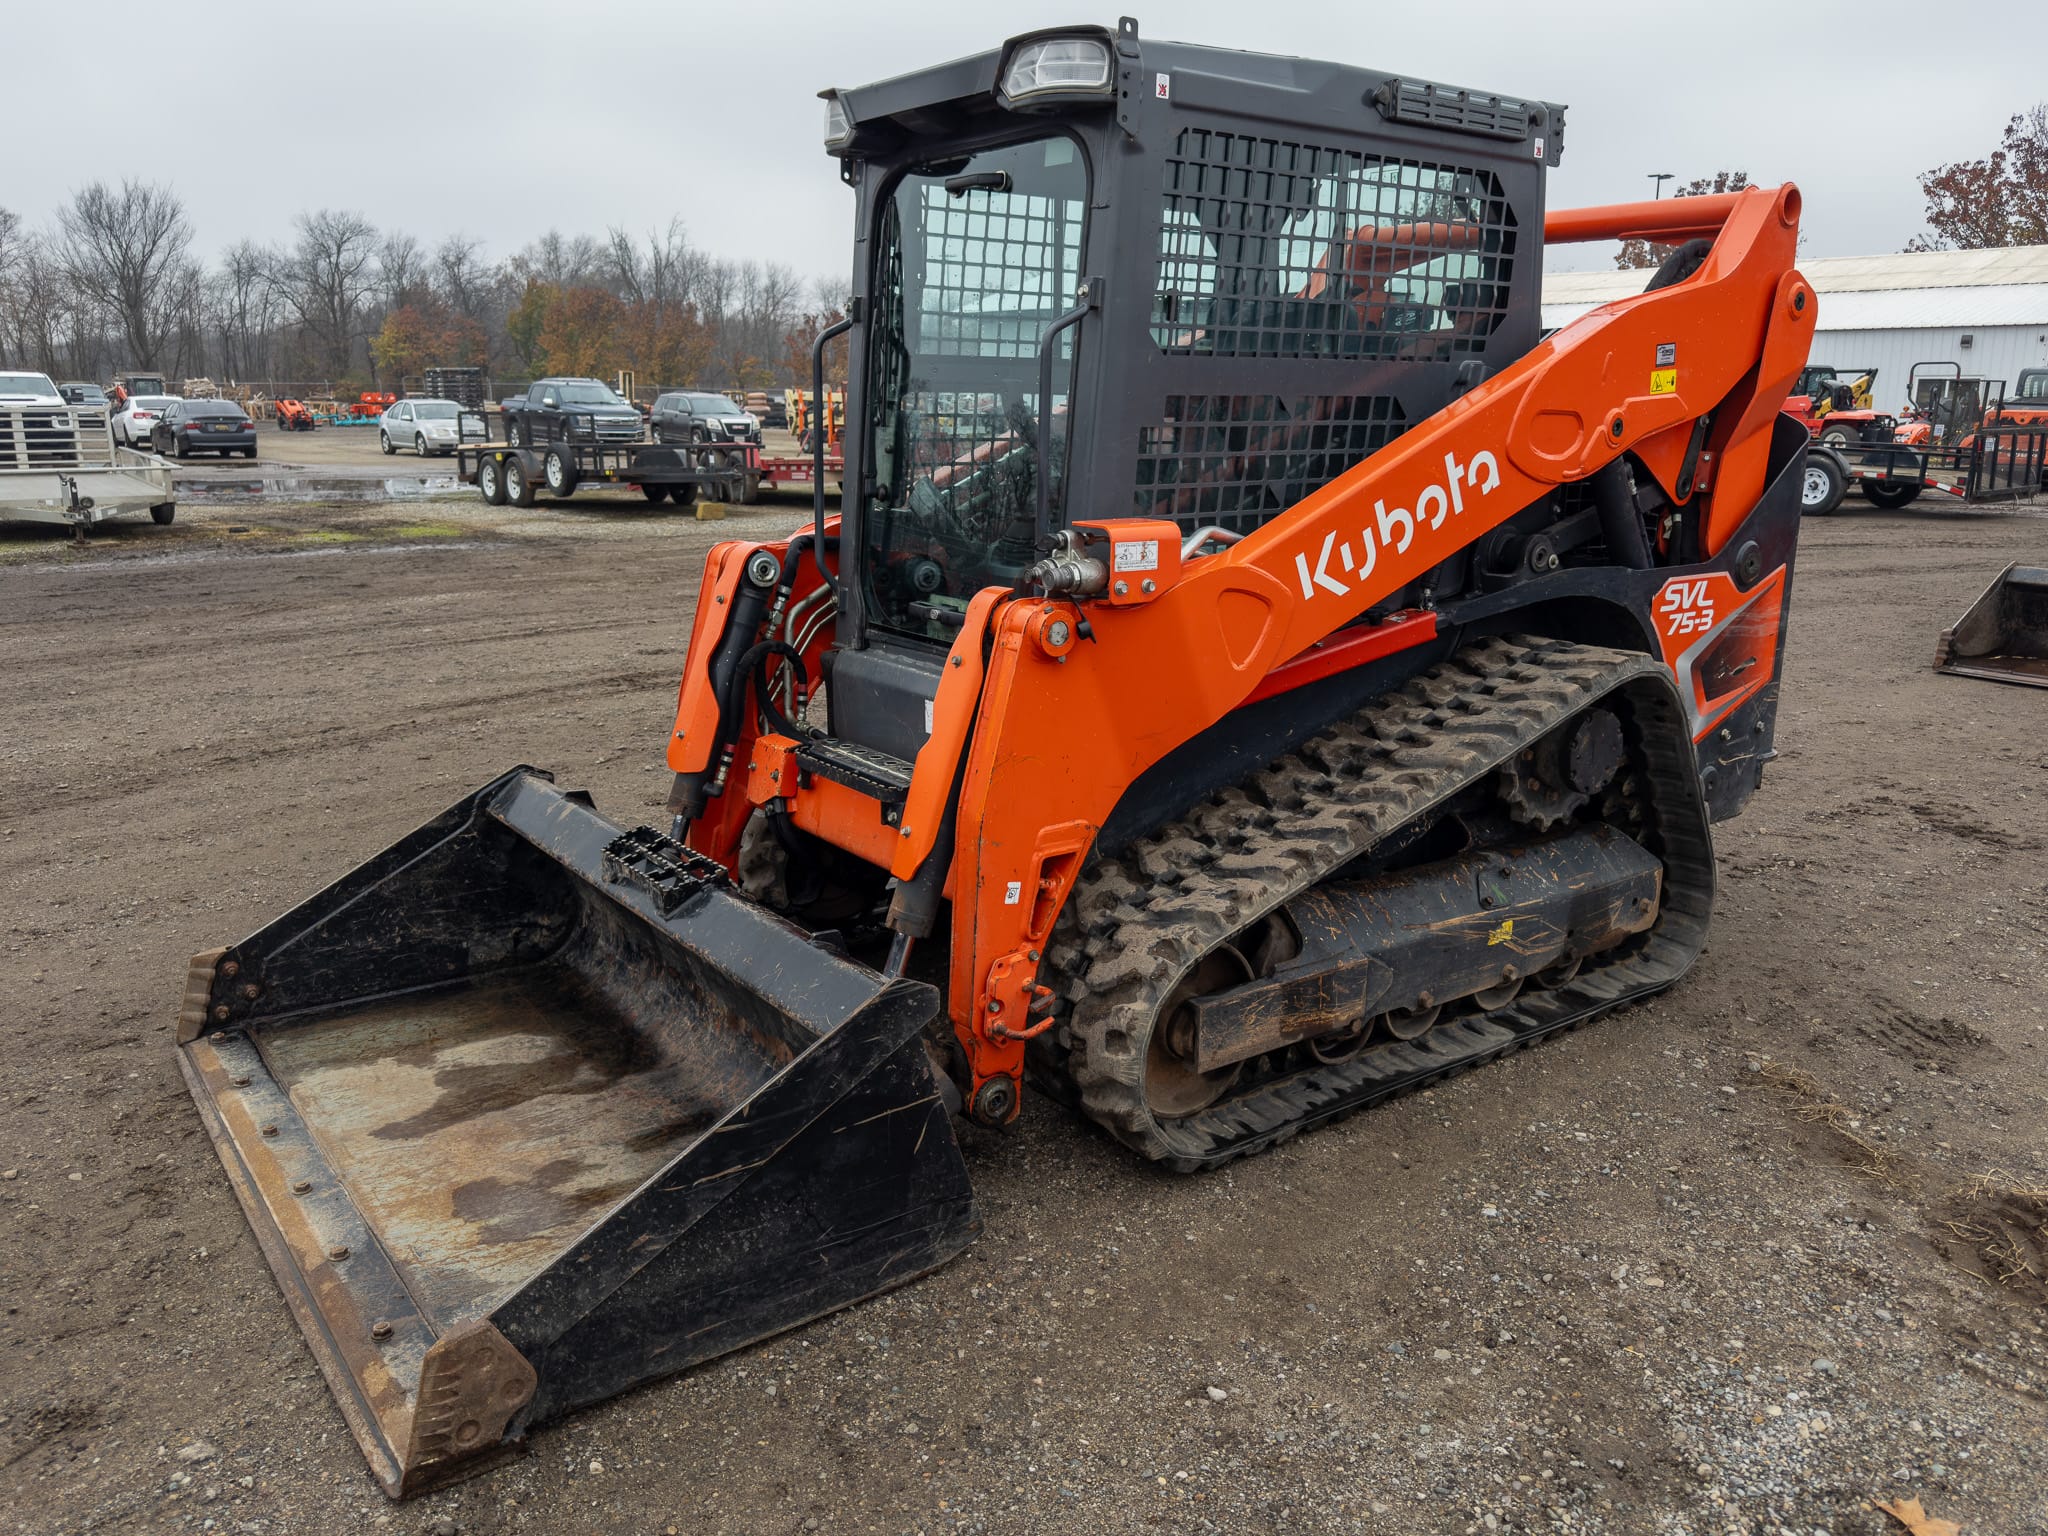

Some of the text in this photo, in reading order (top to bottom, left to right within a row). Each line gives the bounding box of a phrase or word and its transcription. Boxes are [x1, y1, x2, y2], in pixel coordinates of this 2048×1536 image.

[1295, 450, 1500, 600] Kubota
[1660, 581, 1713, 612] SVL
[1667, 609, 1714, 636] 75-3
